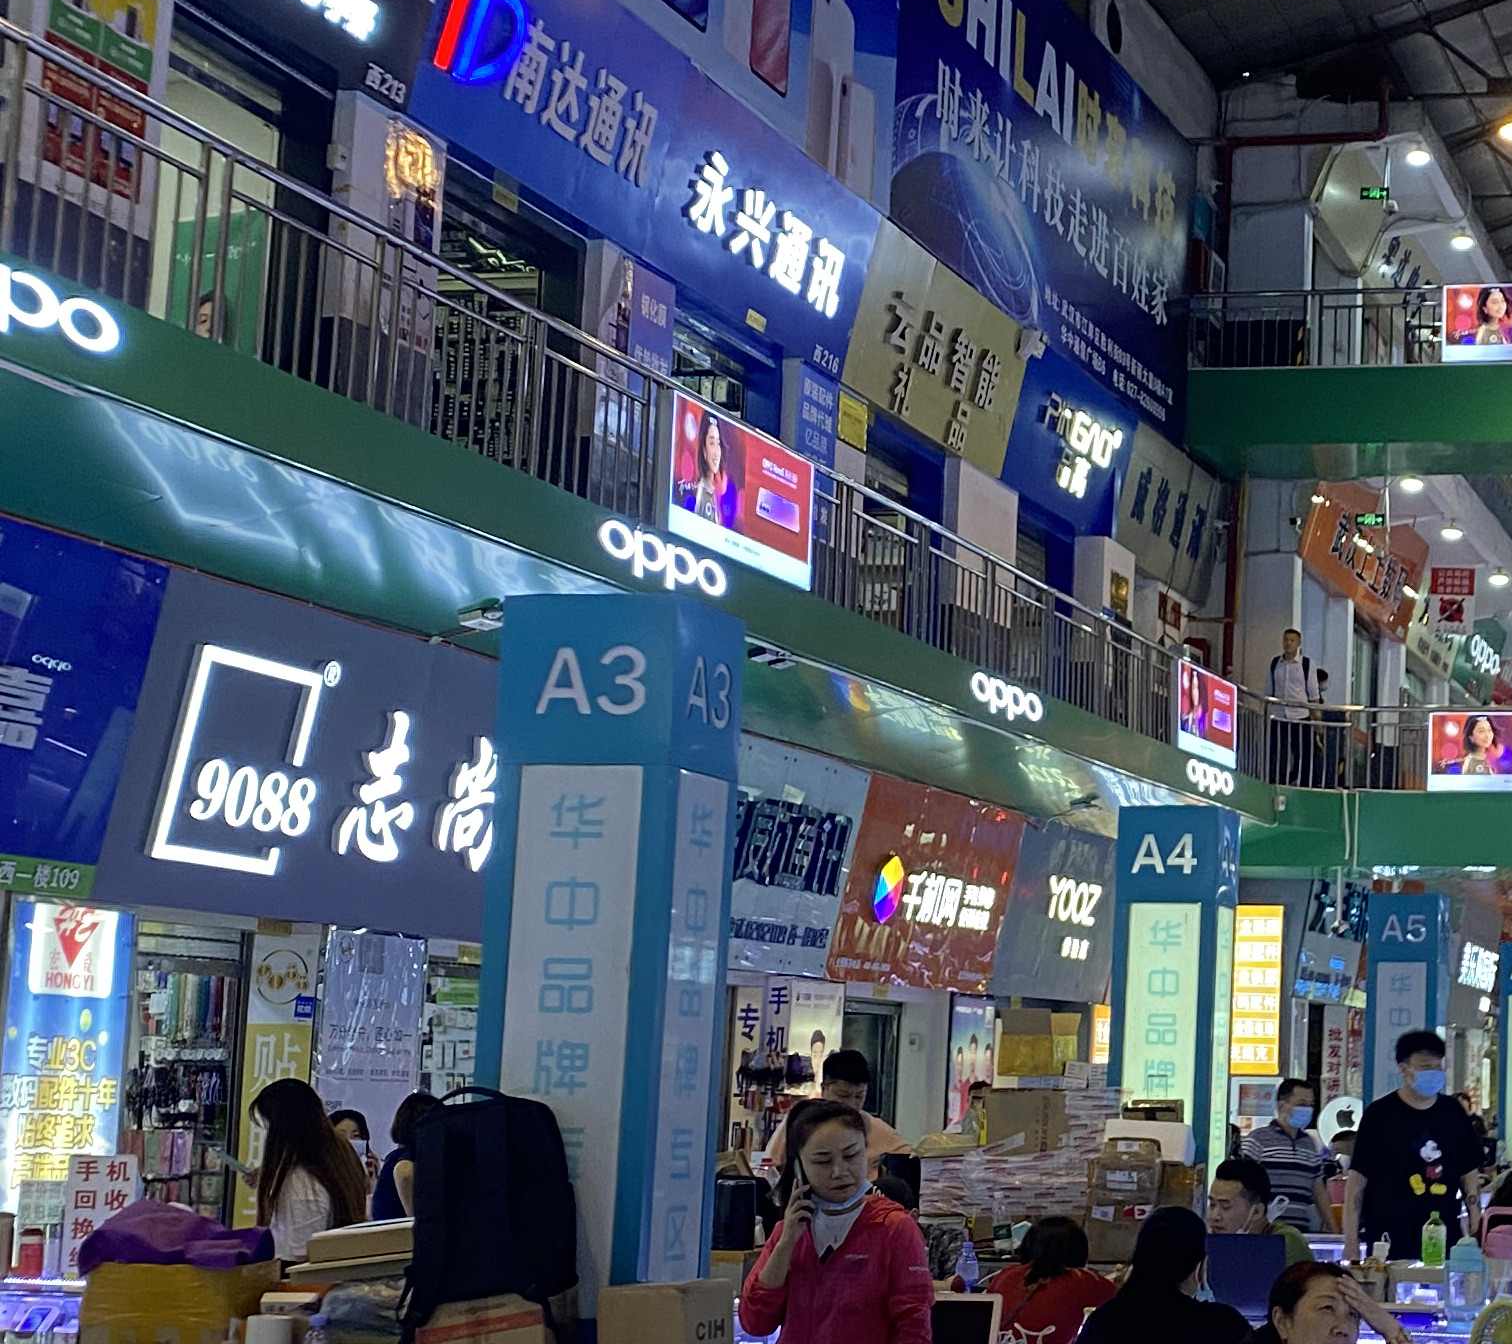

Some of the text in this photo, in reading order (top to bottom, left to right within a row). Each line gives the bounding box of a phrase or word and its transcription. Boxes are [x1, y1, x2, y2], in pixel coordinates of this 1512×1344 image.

[364, 60, 407, 104] 西213
[503, 18, 659, 189] 南达通讯
[936, 58, 1169, 326] 时来让科技走进百姓家
[689, 149, 846, 319] 永兴通讯
[812, 342, 840, 374] 西216
[887, 290, 1001, 414] 云品智能
[599, 518, 727, 597] oppo
[1471, 634, 1500, 676] oppo
[535, 645, 647, 716] A3
[685, 655, 732, 730] A3
[970, 670, 1045, 724] oppo
[189, 758, 316, 837] 9088
[1185, 757, 1235, 798] oppo
[1130, 833, 1198, 875] A4
[1049, 875, 1101, 927] YOOZ
[1381, 913, 1427, 944] A5
[27, 1032, 96, 1072] 专业3C
[0, 1075, 117, 1113] 数码配件十年
[16, 1111, 95, 1151] 始终追求
[75, 1160, 131, 1185] 手机
[74, 1189, 129, 1212] 回收
